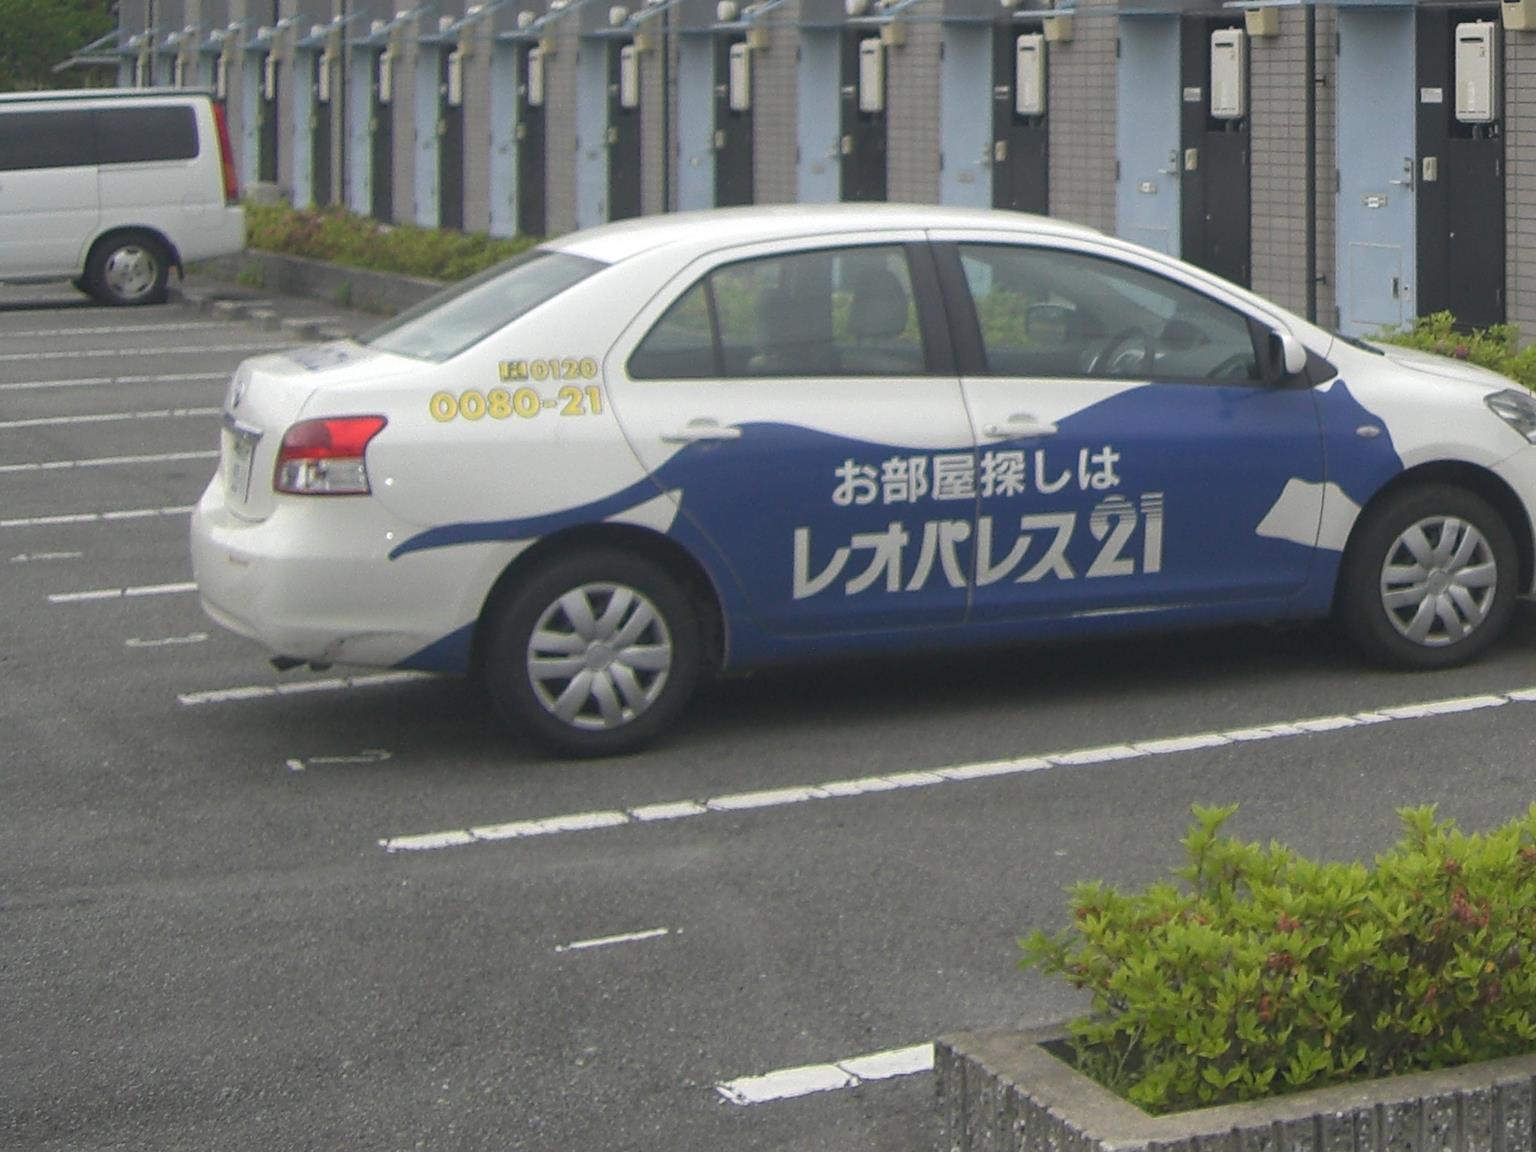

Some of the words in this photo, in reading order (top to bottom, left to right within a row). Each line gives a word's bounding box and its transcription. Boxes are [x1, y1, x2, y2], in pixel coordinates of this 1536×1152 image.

[530, 358, 598, 381] 0120
[429, 386, 602, 423] 0080-21
[832, 446, 1120, 506] お部屋探しは
[793, 493, 1164, 599] レオパレス21
